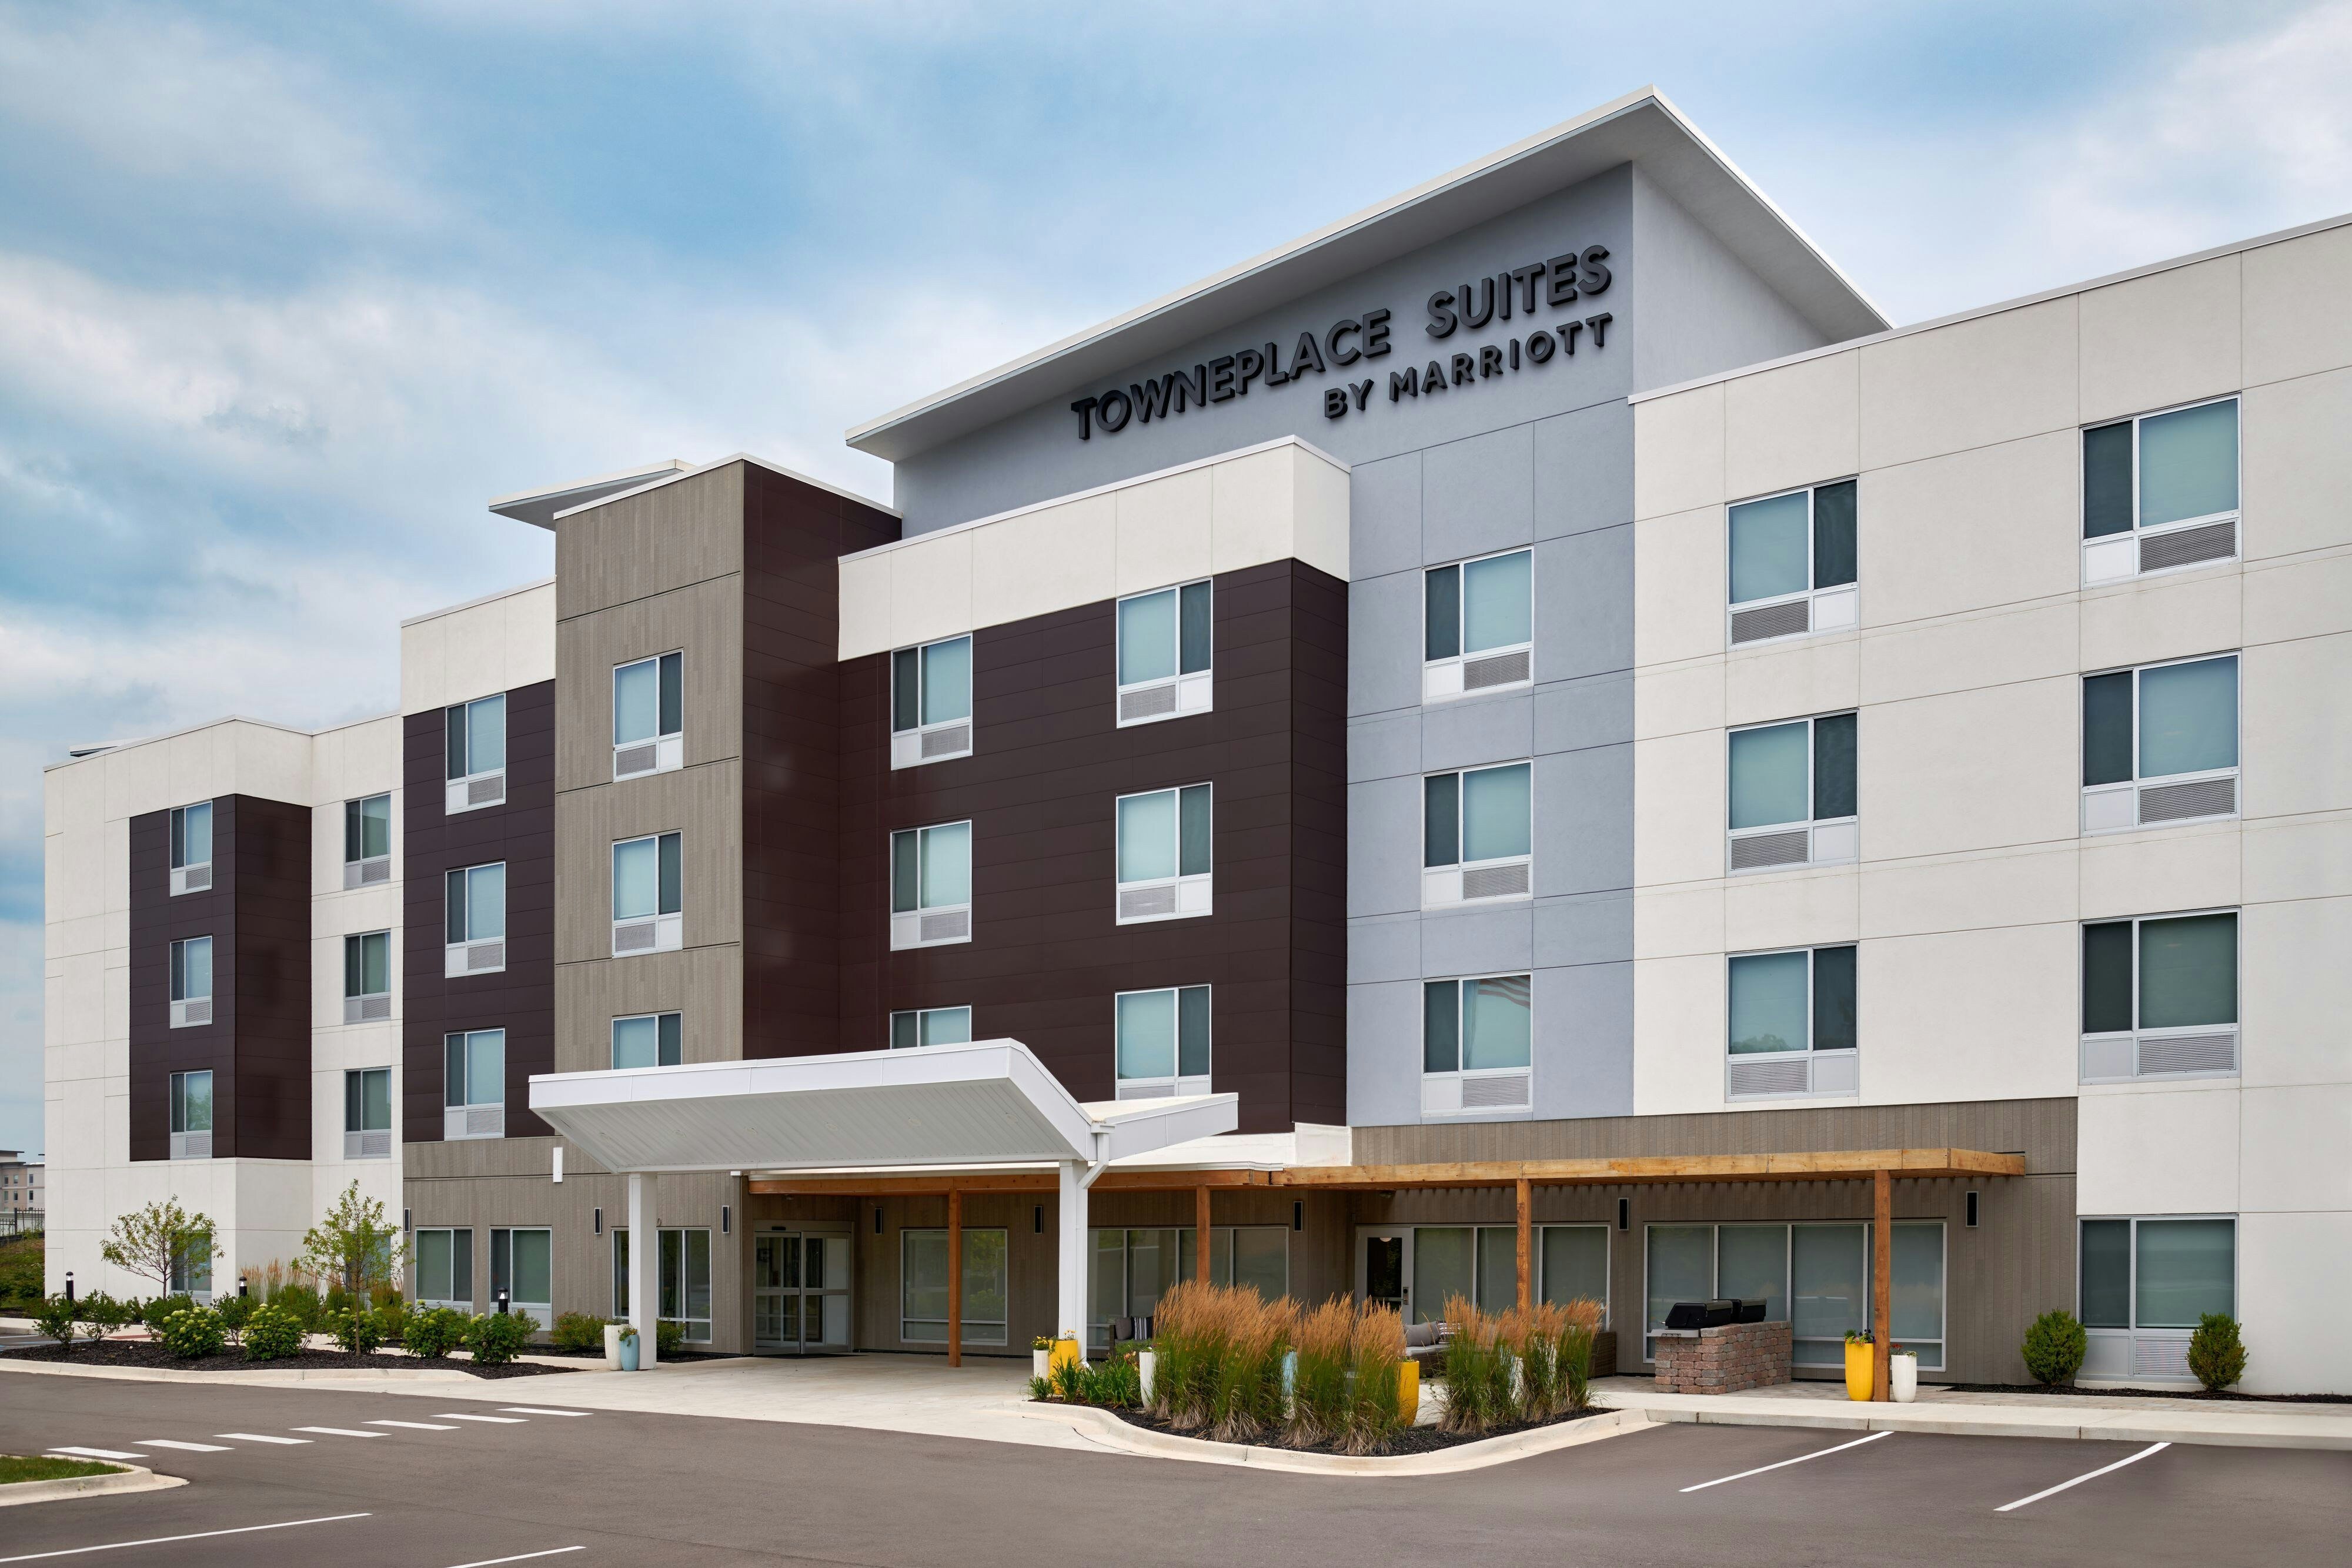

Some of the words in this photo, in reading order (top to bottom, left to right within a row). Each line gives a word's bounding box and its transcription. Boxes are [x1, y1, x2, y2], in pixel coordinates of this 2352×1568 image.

[1071, 308, 1391, 440] TOWNEPLACE
[1425, 245, 1612, 342] SUITES
[1324, 379, 1375, 419] BY
[1389, 312, 1613, 403] MARRIOTT
